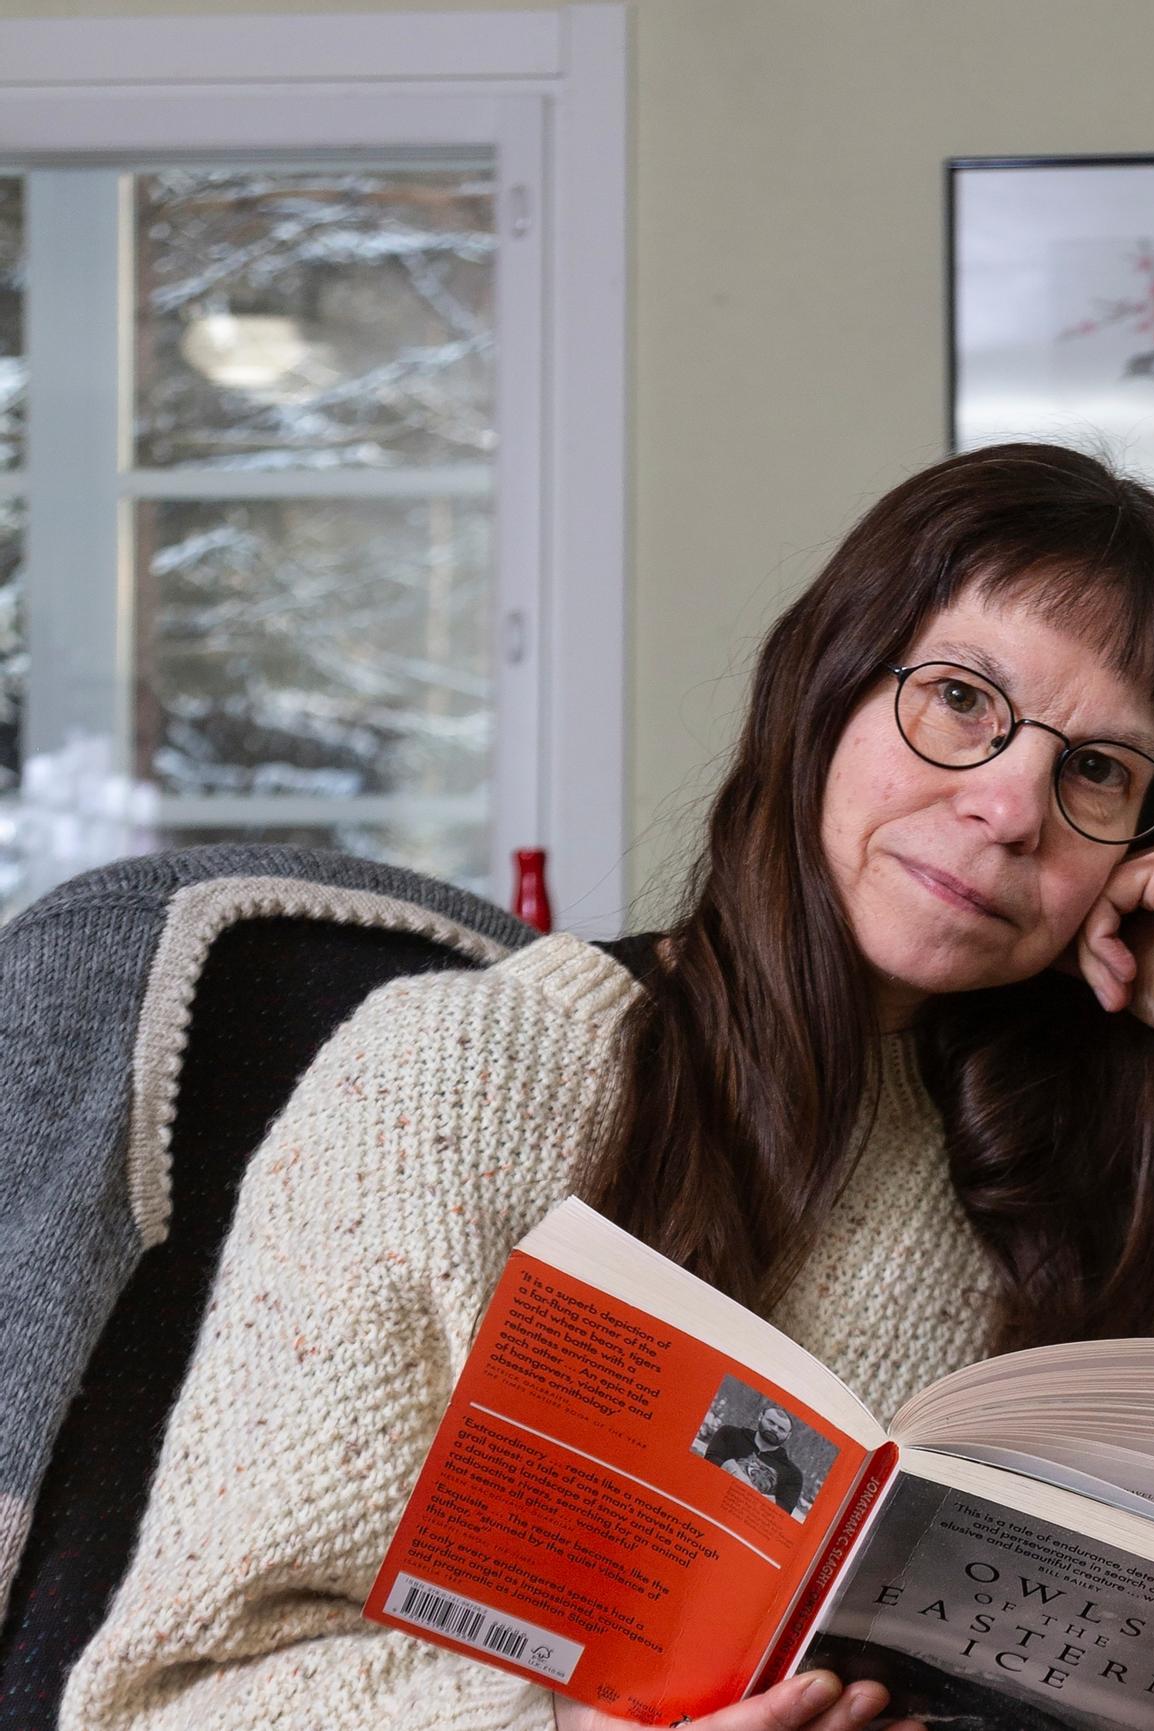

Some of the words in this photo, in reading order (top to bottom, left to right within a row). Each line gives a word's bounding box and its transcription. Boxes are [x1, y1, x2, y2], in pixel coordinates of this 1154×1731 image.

[508, 1308, 534, 1324] and
[534, 1321, 561, 1337] men
[563, 1331, 597, 1355] battle
[600, 1352, 624, 1367] with
[626, 1365, 636, 1374] a
[513, 1296, 548, 1318] world
[549, 1314, 588, 1336] where
[589, 1330, 624, 1356] bears,
[628, 1351, 661, 1373] tigers
[518, 1286, 528, 1295] a
[529, 1288, 580, 1321] far-flung
[581, 1317, 621, 1338] corner
[623, 1337, 637, 1346] of
[637, 1342, 657, 1357] the
[532, 1277, 543, 1288] is
[544, 1285, 554, 1294] a
[555, 1290, 597, 1314] superb
[599, 1311, 655, 1342] depiction
[656, 1340, 672, 1349] of
[489, 1353, 546, 1383] obsessive
[494, 1342, 509, 1352] of
[509, 1345, 573, 1384] hangovers,
[577, 1380, 626, 1407] violence
[627, 1405, 653, 1420] and
[499, 1331, 529, 1349] each
[531, 1346, 563, 1364] other
[578, 1367, 597, 1381] An
[599, 1378, 625, 1394] epic
[626, 1389, 649, 1406] tale
[503, 1319, 558, 1350] relentless
[560, 1346, 634, 1385] environment
[635, 1382, 660, 1398] and
[425, 1503, 446, 1518] this
[443, 1459, 468, 1475] that
[469, 1472, 506, 1492] seems
[507, 1489, 524, 1500] all
[524, 1497, 559, 1515] ghost
[448, 1451, 515, 1484] radioactive
[555, 1494, 612, 1529] searching
[613, 1521, 631, 1537] for
[633, 1534, 649, 1546] an
[650, 1543, 691, 1568] animal
[452, 1440, 462, 1448] a
[464, 1444, 517, 1473] daunting
[519, 1466, 580, 1501] landscape
[582, 1497, 597, 1507] of
[597, 1503, 628, 1522] snow
[629, 1520, 654, 1536] and
[654, 1531, 672, 1545] ice
[673, 1543, 698, 1559] and
[457, 1429, 487, 1445] grail
[524, 1459, 535, 1467] a
[536, 1463, 559, 1478] tale
[561, 1475, 576, 1484] of
[576, 1482, 599, 1496] one
[636, 1510, 673, 1534] travels
[675, 1530, 719, 1560] through
[564, 1464, 599, 1483] reads
[600, 1478, 621, 1494] like
[622, 1491, 632, 1500] a
[633, 1497, 705, 1538] modern-day
[842, 1475, 880, 1536] JONATHAN
[508, 1512, 528, 1527] The
[530, 1524, 572, 1546] reader
[630, 1567, 649, 1583] like
[651, 1579, 669, 1594] the
[527, 1532, 544, 1547] by
[545, 1541, 564, 1556] the
[566, 1552, 596, 1569] quiet
[598, 1566, 645, 1593] violence
[647, 1591, 661, 1600] of
[817, 1547, 843, 1588] SLAGHT
[835, 1534, 849, 1549] C.
[939, 1521, 983, 1539] elusive
[986, 1537, 1013, 1550] and
[1014, 1542, 1072, 1571] beautiful
[1072, 1568, 1125, 1591] creature
[972, 1521, 1000, 1535] and
[999, 1529, 1086, 1571] perseverance
[1089, 1561, 1101, 1572] in
[1103, 1569, 1146, 1589] search
[983, 1512, 995, 1523] is
[995, 1519, 1006, 1527] a
[1008, 1522, 1033, 1536] tale
[1035, 1534, 1052, 1542] of
[1052, 1540, 1122, 1571] endurance,
[406, 1544, 432, 1562] and
[432, 1559, 493, 1588] pragmatic
[495, 1583, 509, 1594] as
[510, 1588, 565, 1616] Jonathan
[411, 1537, 466, 1569] guardian
[468, 1559, 503, 1578] angel
[503, 1575, 518, 1585] as
[597, 1615, 663, 1653] courageous
[428, 1532, 455, 1549] only
[456, 1543, 491, 1562] every
[492, 1558, 565, 1593] endangered
[567, 1589, 608, 1613] species
[610, 1606, 635, 1625] had
[635, 1622, 645, 1630] a
[964, 1561, 1146, 1636] OWLS
[1037, 1565, 1059, 1577] BILL
[1063, 1575, 1102, 1592] BAILEY
[973, 1592, 1016, 1612] OF
[1041, 1613, 1109, 1648] THE
[961, 1638, 1070, 1690] ICE
